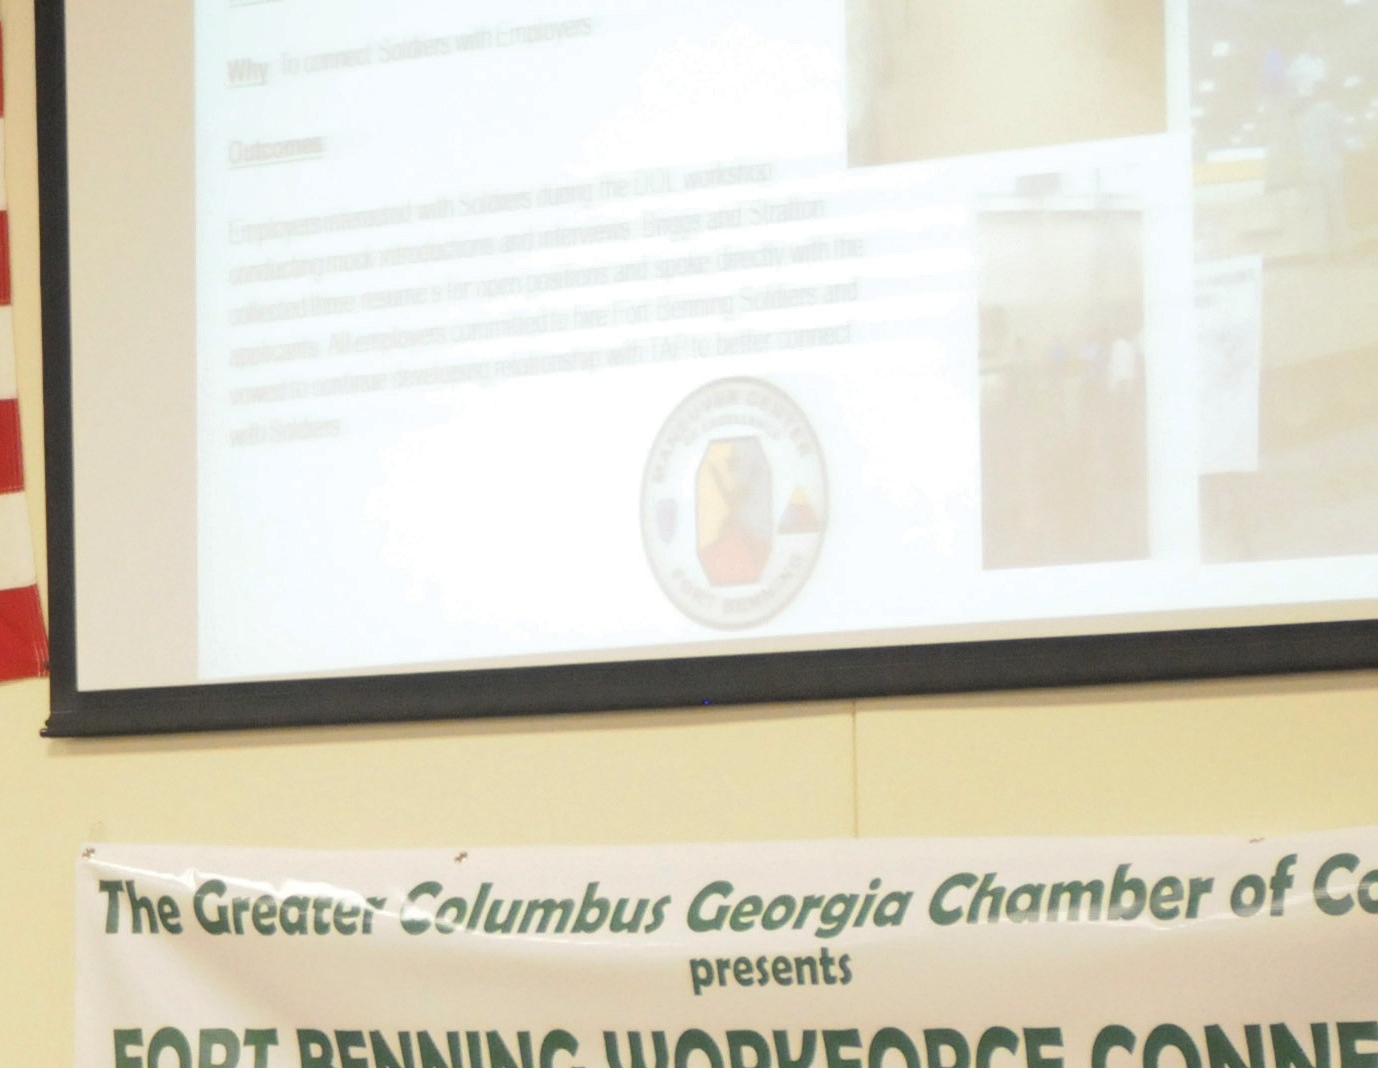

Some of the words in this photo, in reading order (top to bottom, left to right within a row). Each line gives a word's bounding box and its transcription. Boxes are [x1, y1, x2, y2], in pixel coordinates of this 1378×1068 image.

[379, 36, 452, 64] Soldiers
[456, 27, 493, 52] with
[495, 16, 594, 48] Employers
[99, 879, 183, 935] The
[192, 879, 387, 936] Greater
[400, 880, 672, 935] Columbus
[686, 877, 914, 939] Georgia
[928, 863, 1215, 926] Chamber
[1229, 853, 1298, 917] of
[689, 947, 853, 996] presents
